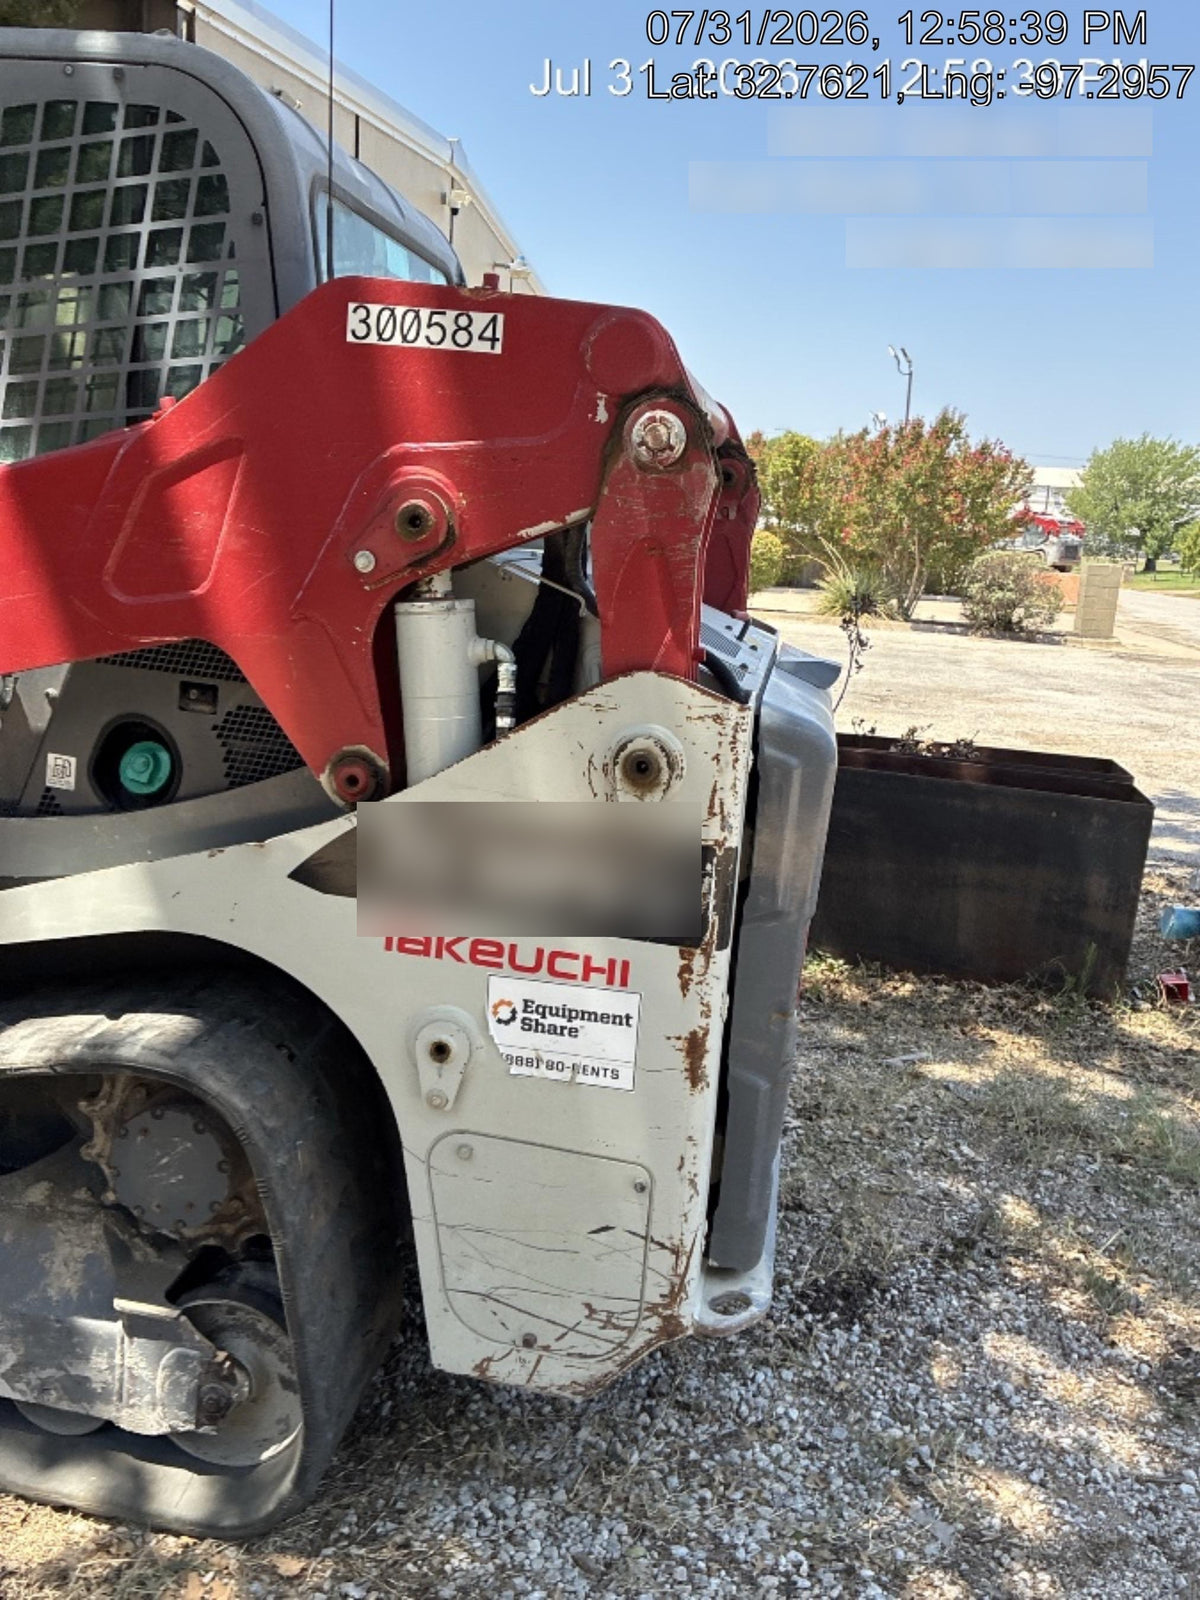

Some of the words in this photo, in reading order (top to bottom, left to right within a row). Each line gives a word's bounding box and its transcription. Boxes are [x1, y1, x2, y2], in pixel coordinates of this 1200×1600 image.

[350, 304, 501, 351] 300584
[520, 1016, 579, 1039] Share
[521, 998, 634, 1028] Equipment
